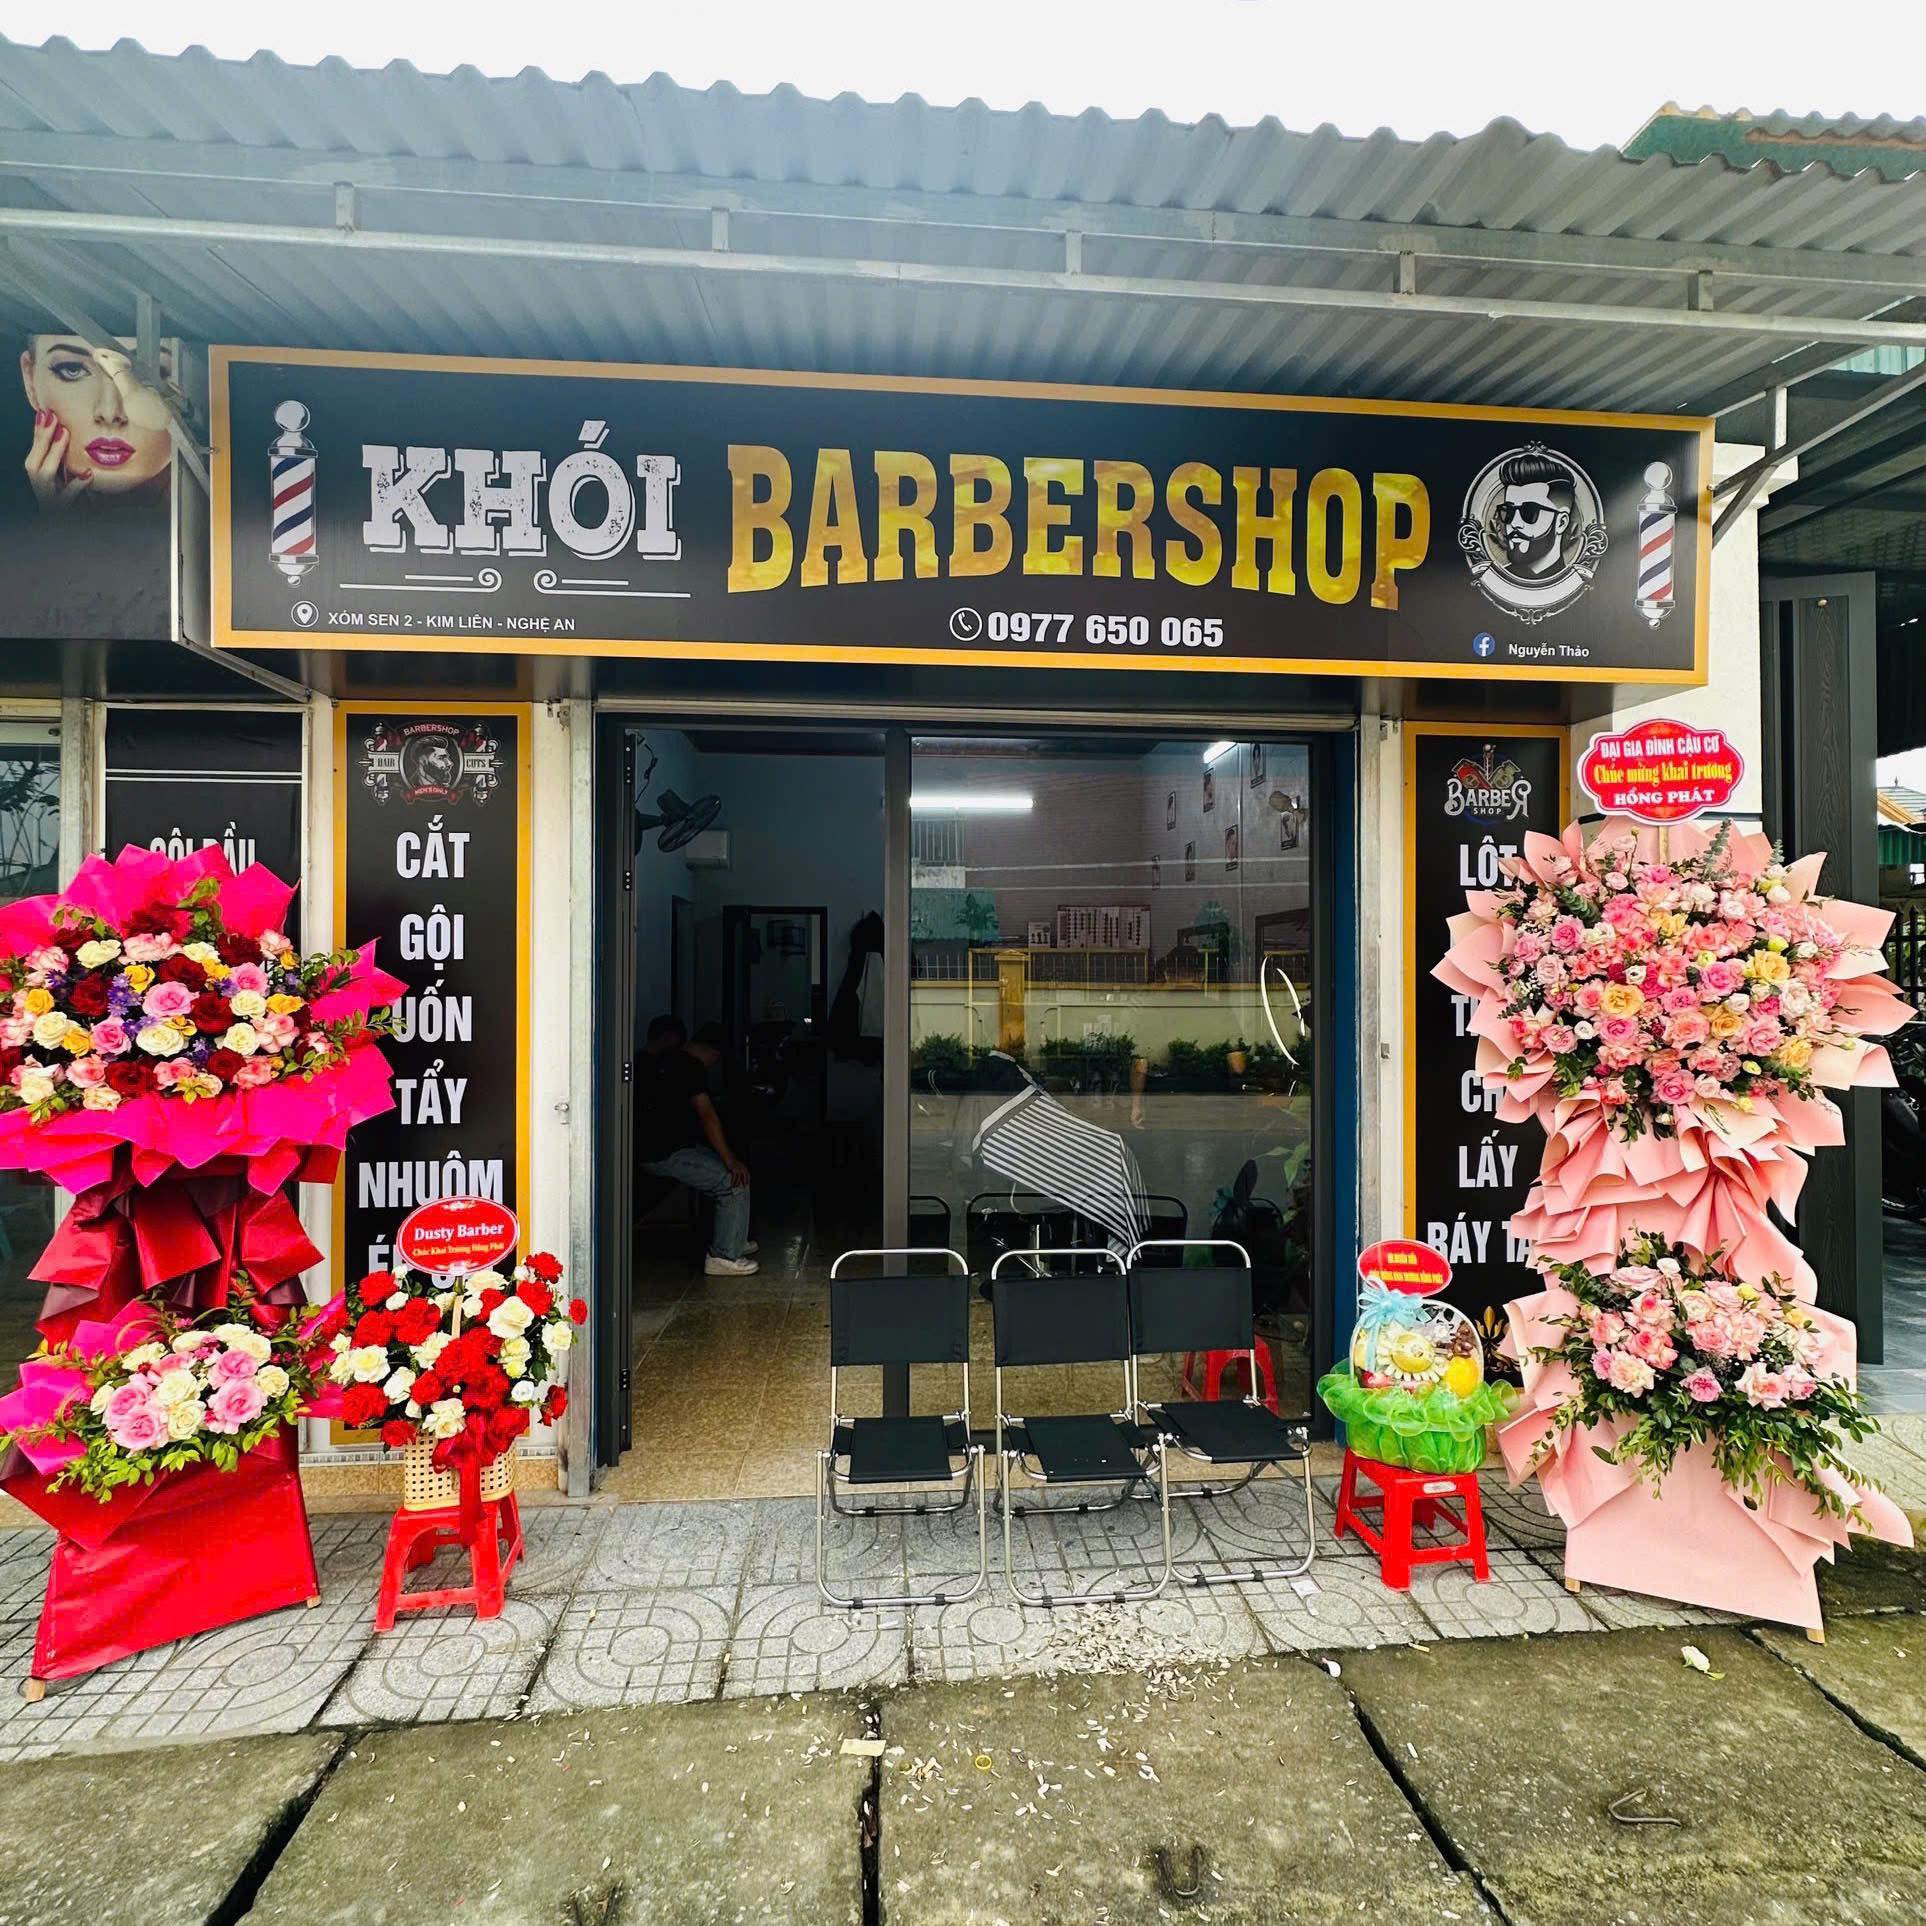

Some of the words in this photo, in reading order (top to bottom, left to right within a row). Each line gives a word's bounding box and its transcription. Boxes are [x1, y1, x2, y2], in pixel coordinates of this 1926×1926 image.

[362, 420, 682, 562] KHÓI
[727, 444, 1431, 611] BARBERSHOP
[328, 610, 364, 626] XÓM
[368, 614, 399, 626] SEN
[403, 615, 413, 627] 2
[426, 616, 454, 628] KIM
[459, 614, 493, 629] LIÊN
[507, 617, 550, 633] NGHỆ
[554, 618, 575, 631] AN
[987, 611, 1075, 642] 0977
[1086, 614, 1150, 645] 650
[1161, 617, 1224, 647] 065
[403, 724, 459, 736] BARBERSHOP
[1623, 740, 1644, 757] GIA
[378, 757, 395, 767] HAIR
[466, 758, 487, 769] CUTS
[1662, 761, 1689, 780] khai
[1667, 786, 1715, 803] PHÁT
[1473, 807, 1502, 815] SHOP
[397, 815, 470, 879] CẮT
[400, 904, 464, 971] GỘI
[396, 1059, 468, 1125] TẨY
[1459, 1130, 1519, 1188] LẤY
[414, 1227, 454, 1242] Dusty
[457, 1222, 505, 1238] Barber
